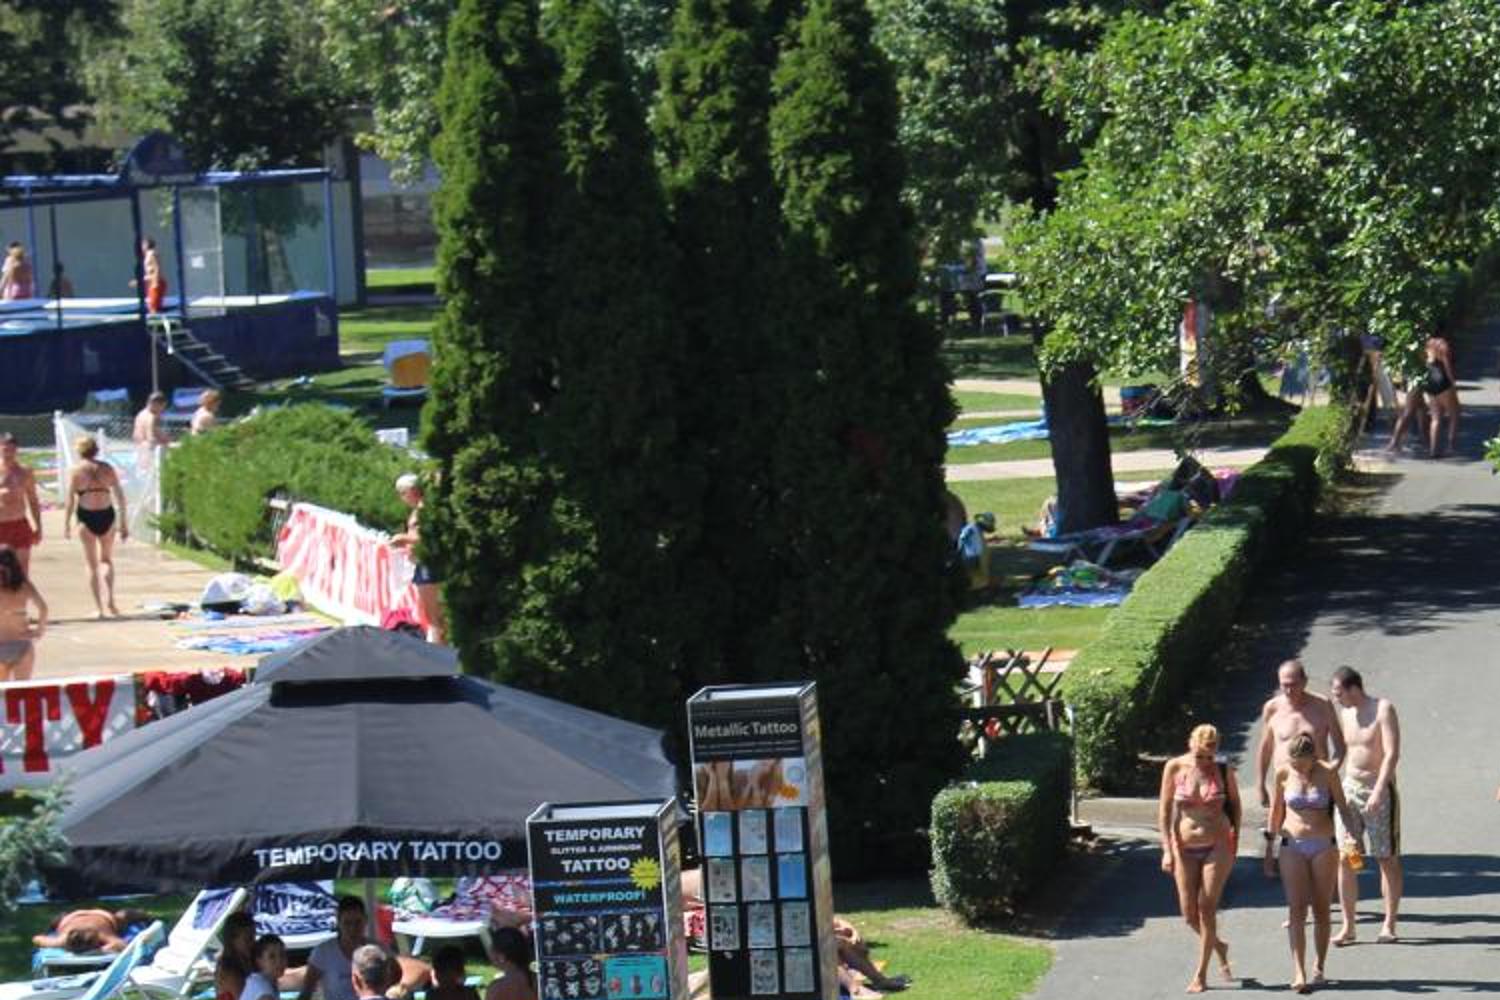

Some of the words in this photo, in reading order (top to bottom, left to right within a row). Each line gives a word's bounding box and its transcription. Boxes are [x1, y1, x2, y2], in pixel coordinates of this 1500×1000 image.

[695, 721, 749, 737] Metallic
[750, 721, 798, 736] Tattoo
[544, 826, 646, 842] TEMPORARY
[253, 841, 402, 867] TEMPORARY
[409, 841, 501, 861] TATTOO
[561, 857, 631, 873] TATTOO
